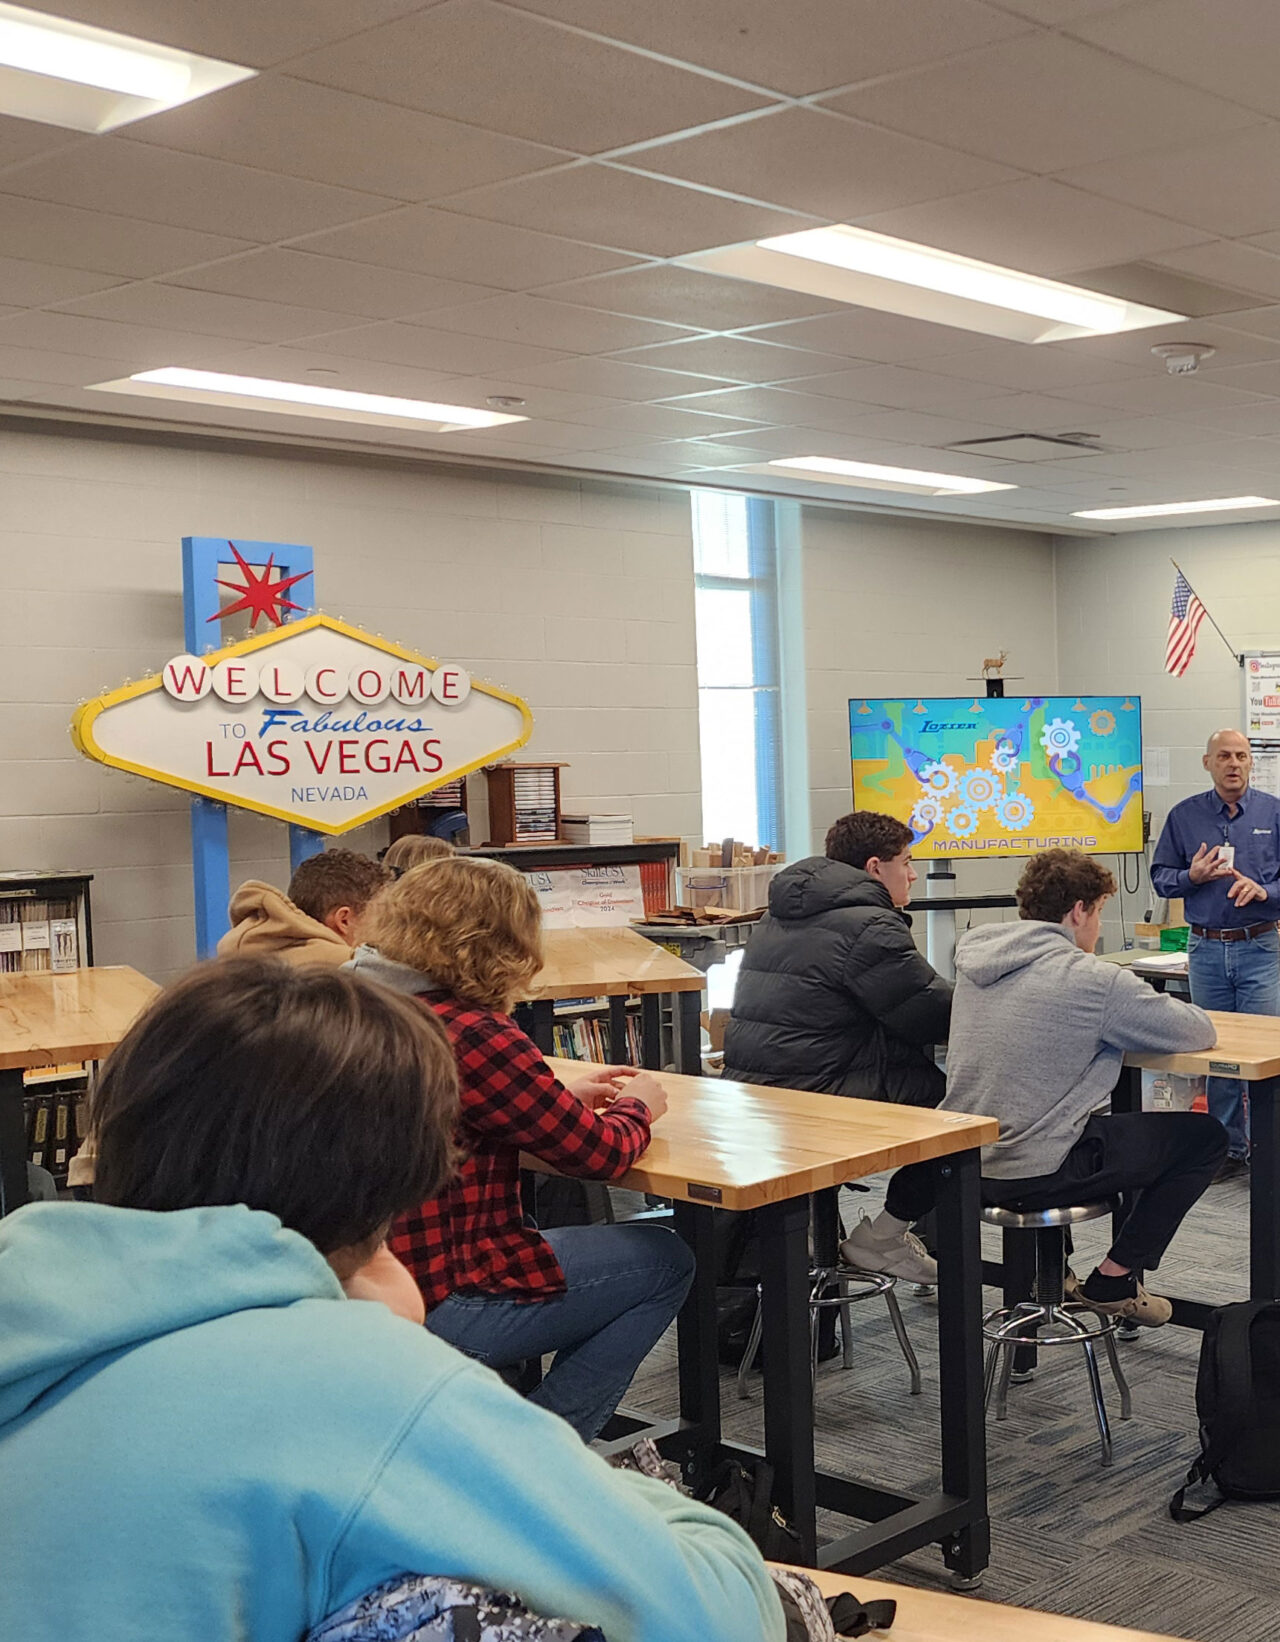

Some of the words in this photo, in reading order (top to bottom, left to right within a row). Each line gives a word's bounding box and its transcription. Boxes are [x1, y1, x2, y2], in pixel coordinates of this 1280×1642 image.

[168, 664, 460, 699] WELCOME
[219, 723, 246, 740] TO
[258, 708, 434, 739] Fabulous
[206, 740, 291, 777] LAS
[304, 739, 444, 774] VEGAS
[291, 786, 369, 803] NEVADA
[933, 836, 1097, 851] MANUFACTURING
